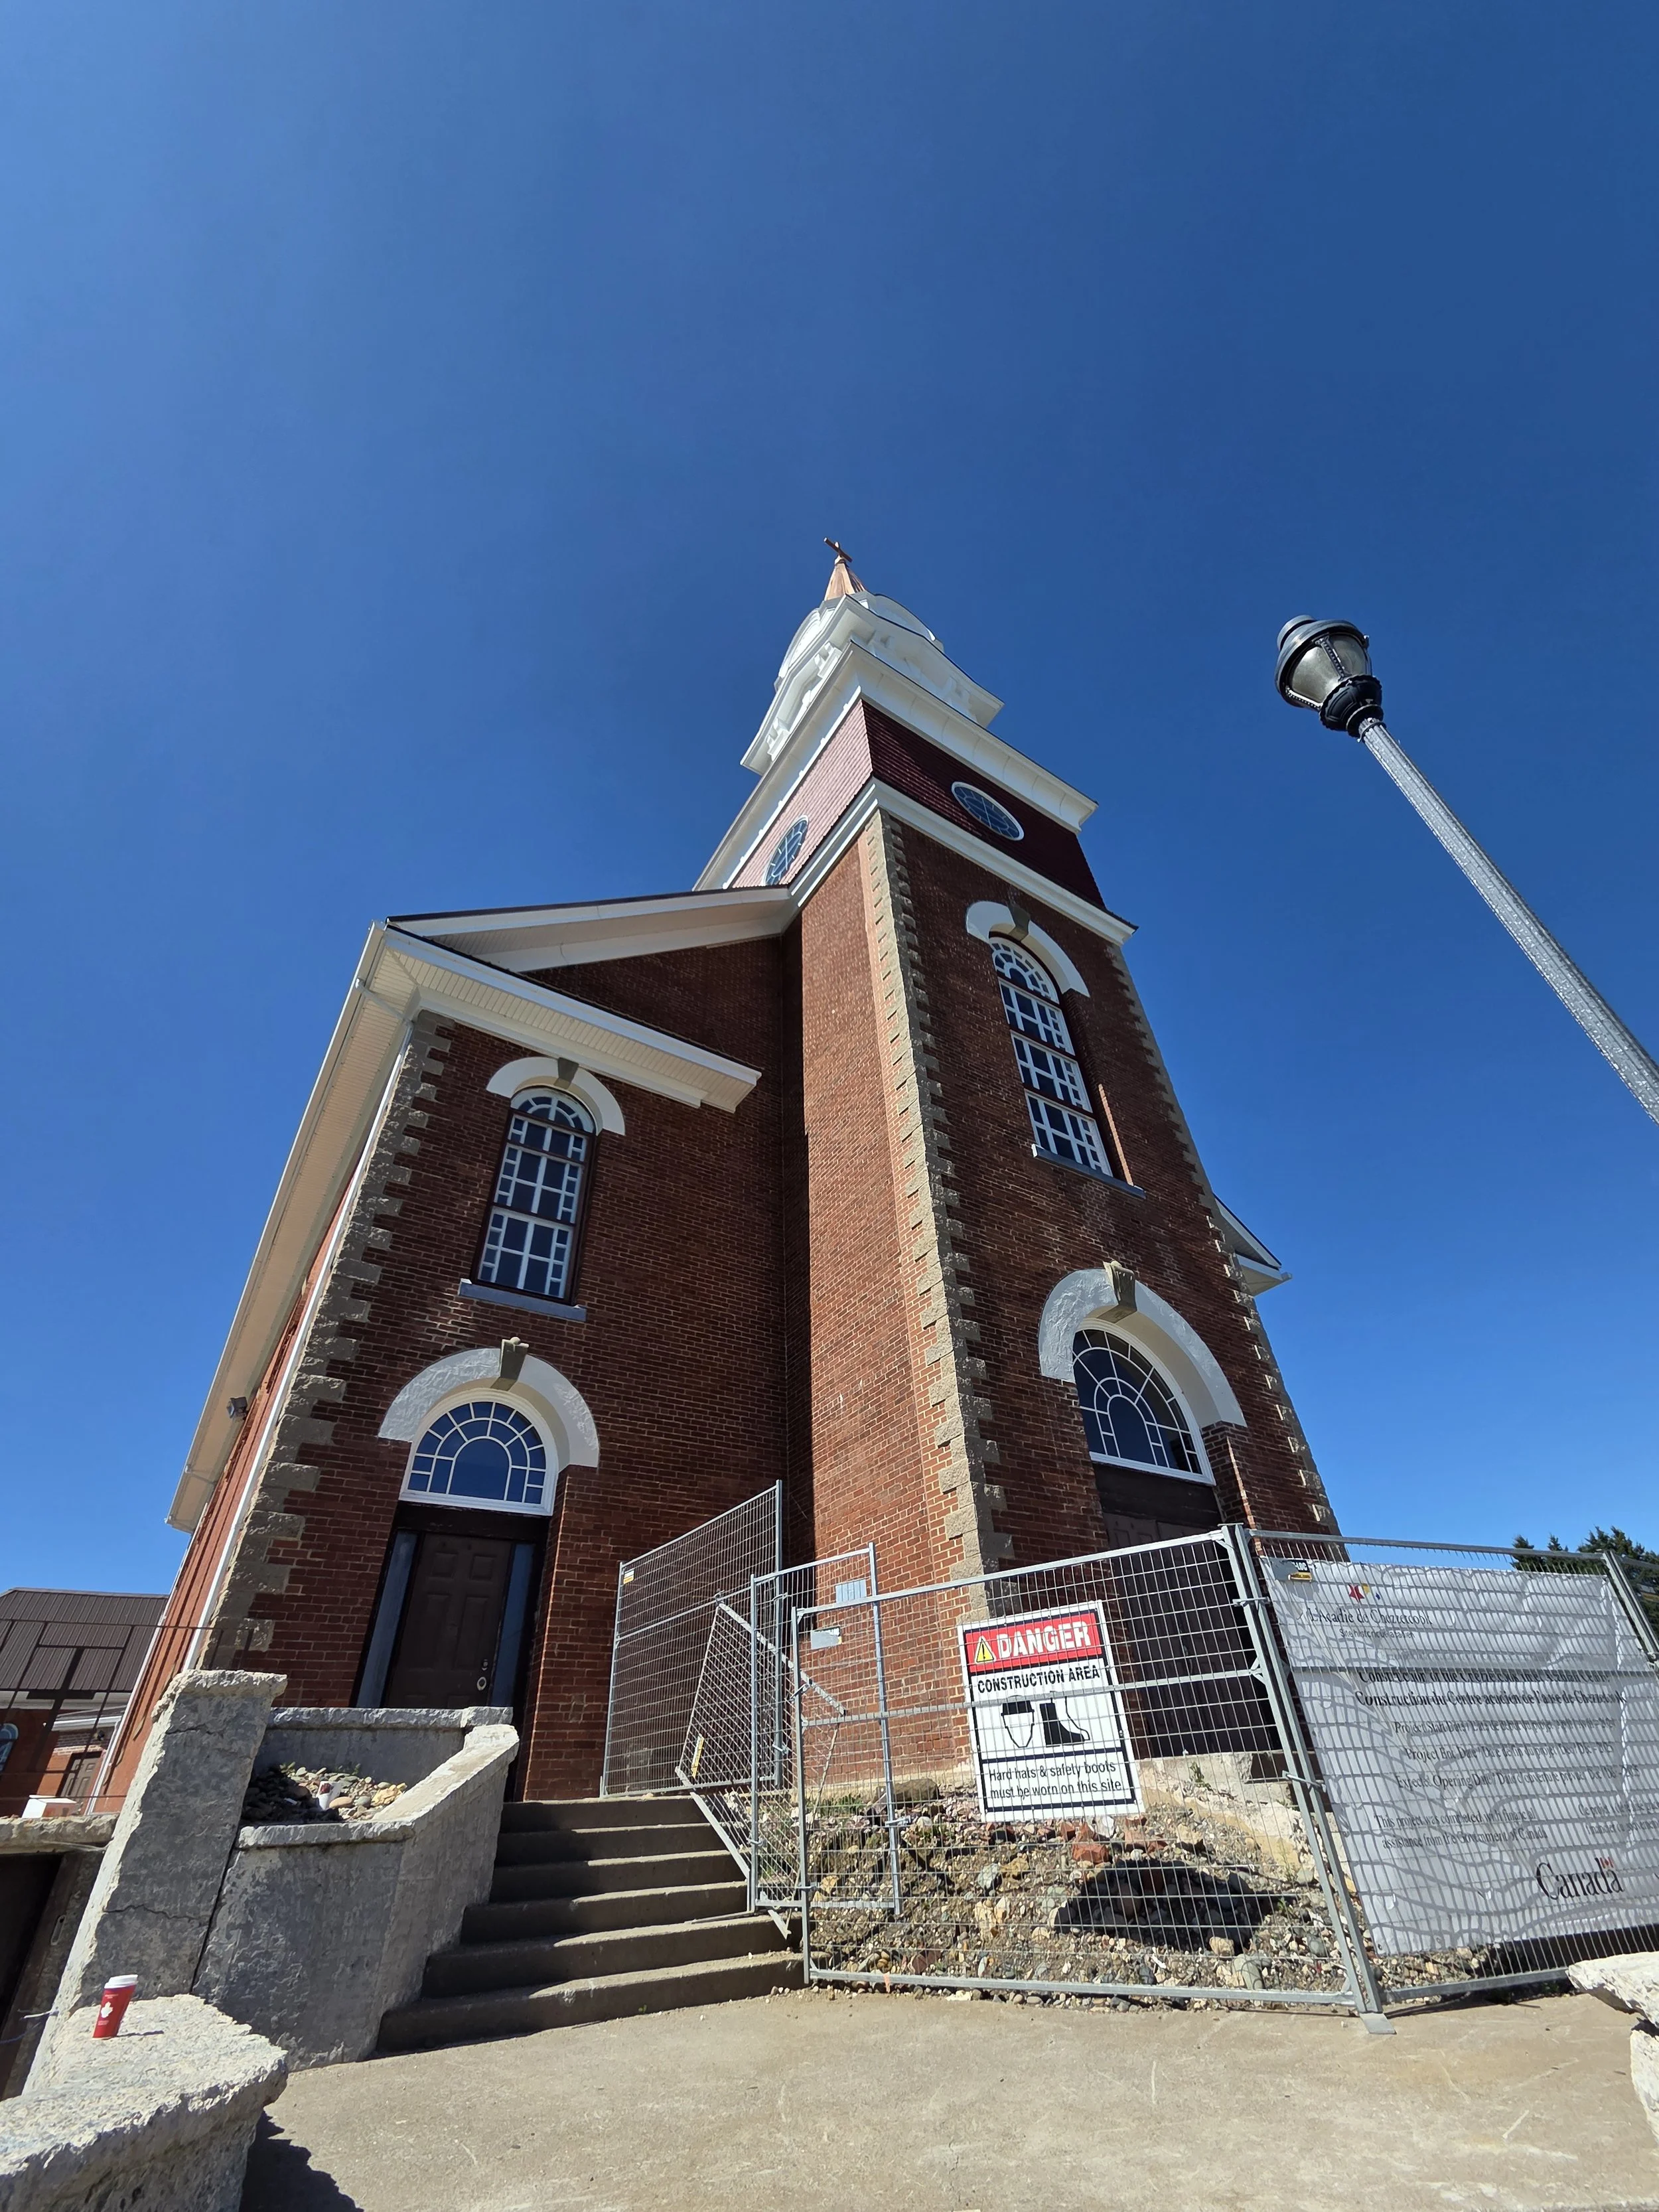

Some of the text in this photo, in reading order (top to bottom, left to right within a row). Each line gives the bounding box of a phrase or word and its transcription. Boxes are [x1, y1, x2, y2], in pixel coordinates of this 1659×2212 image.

[1356, 1608, 1370, 1623] de
[996, 1621, 1091, 1659] DANGER
[1339, 1628, 1352, 1638] Site
[977, 1664, 1100, 1694] CONSTRUCTION AREA
[1354, 1690, 1431, 1706] Construction
[1432, 1691, 1447, 1706] du
[1447, 1690, 1483, 1706] Centre
[1394, 1721, 1425, 1735] Project
[1404, 1747, 1439, 1763] Project
[989, 1760, 1116, 1781] Hard hats & safety boots
[990, 1778, 1122, 1799] must be worn on this site
[1432, 1774, 1475, 1790] Opening
[1374, 1814, 1396, 1828] This
[1396, 1815, 1423, 1830] project
[1424, 1815, 1441, 1825] was
[1440, 1810, 1482, 1827] completed
[1382, 1836, 1423, 1850] assistance
[1423, 1833, 1443, 1846] from
[1443, 1831, 1457, 1845] the
[1457, 1830, 1508, 1844] Government
[1536, 1857, 1625, 1900] Canada
